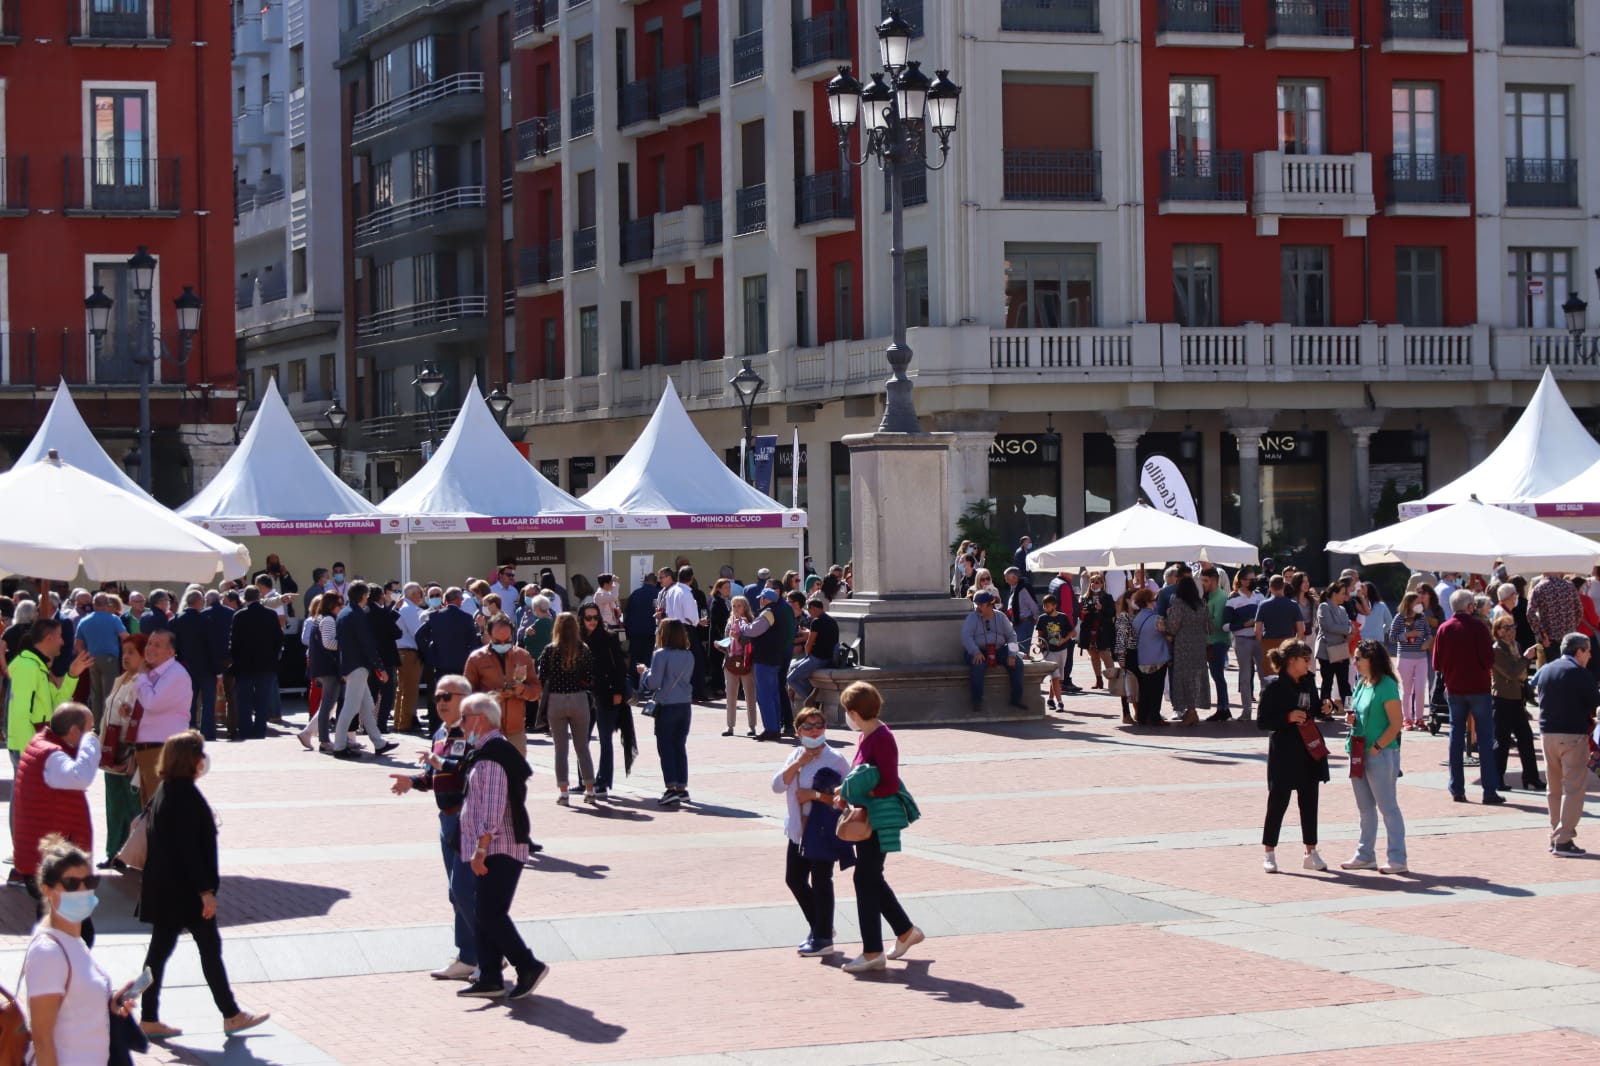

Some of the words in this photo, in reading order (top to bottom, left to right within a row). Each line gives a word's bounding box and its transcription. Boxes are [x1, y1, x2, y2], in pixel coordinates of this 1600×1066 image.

[990, 439, 1038, 455] NGO
[529, 517, 540, 525] DE
[541, 517, 564, 525] MOHA
[690, 515, 724, 523] DOMINIO
[725, 515, 738, 523] DEL
[261, 521, 294, 529] BODEGAS
[295, 521, 323, 529] ERESMA
[335, 520, 376, 528] SOTERRAÑA
